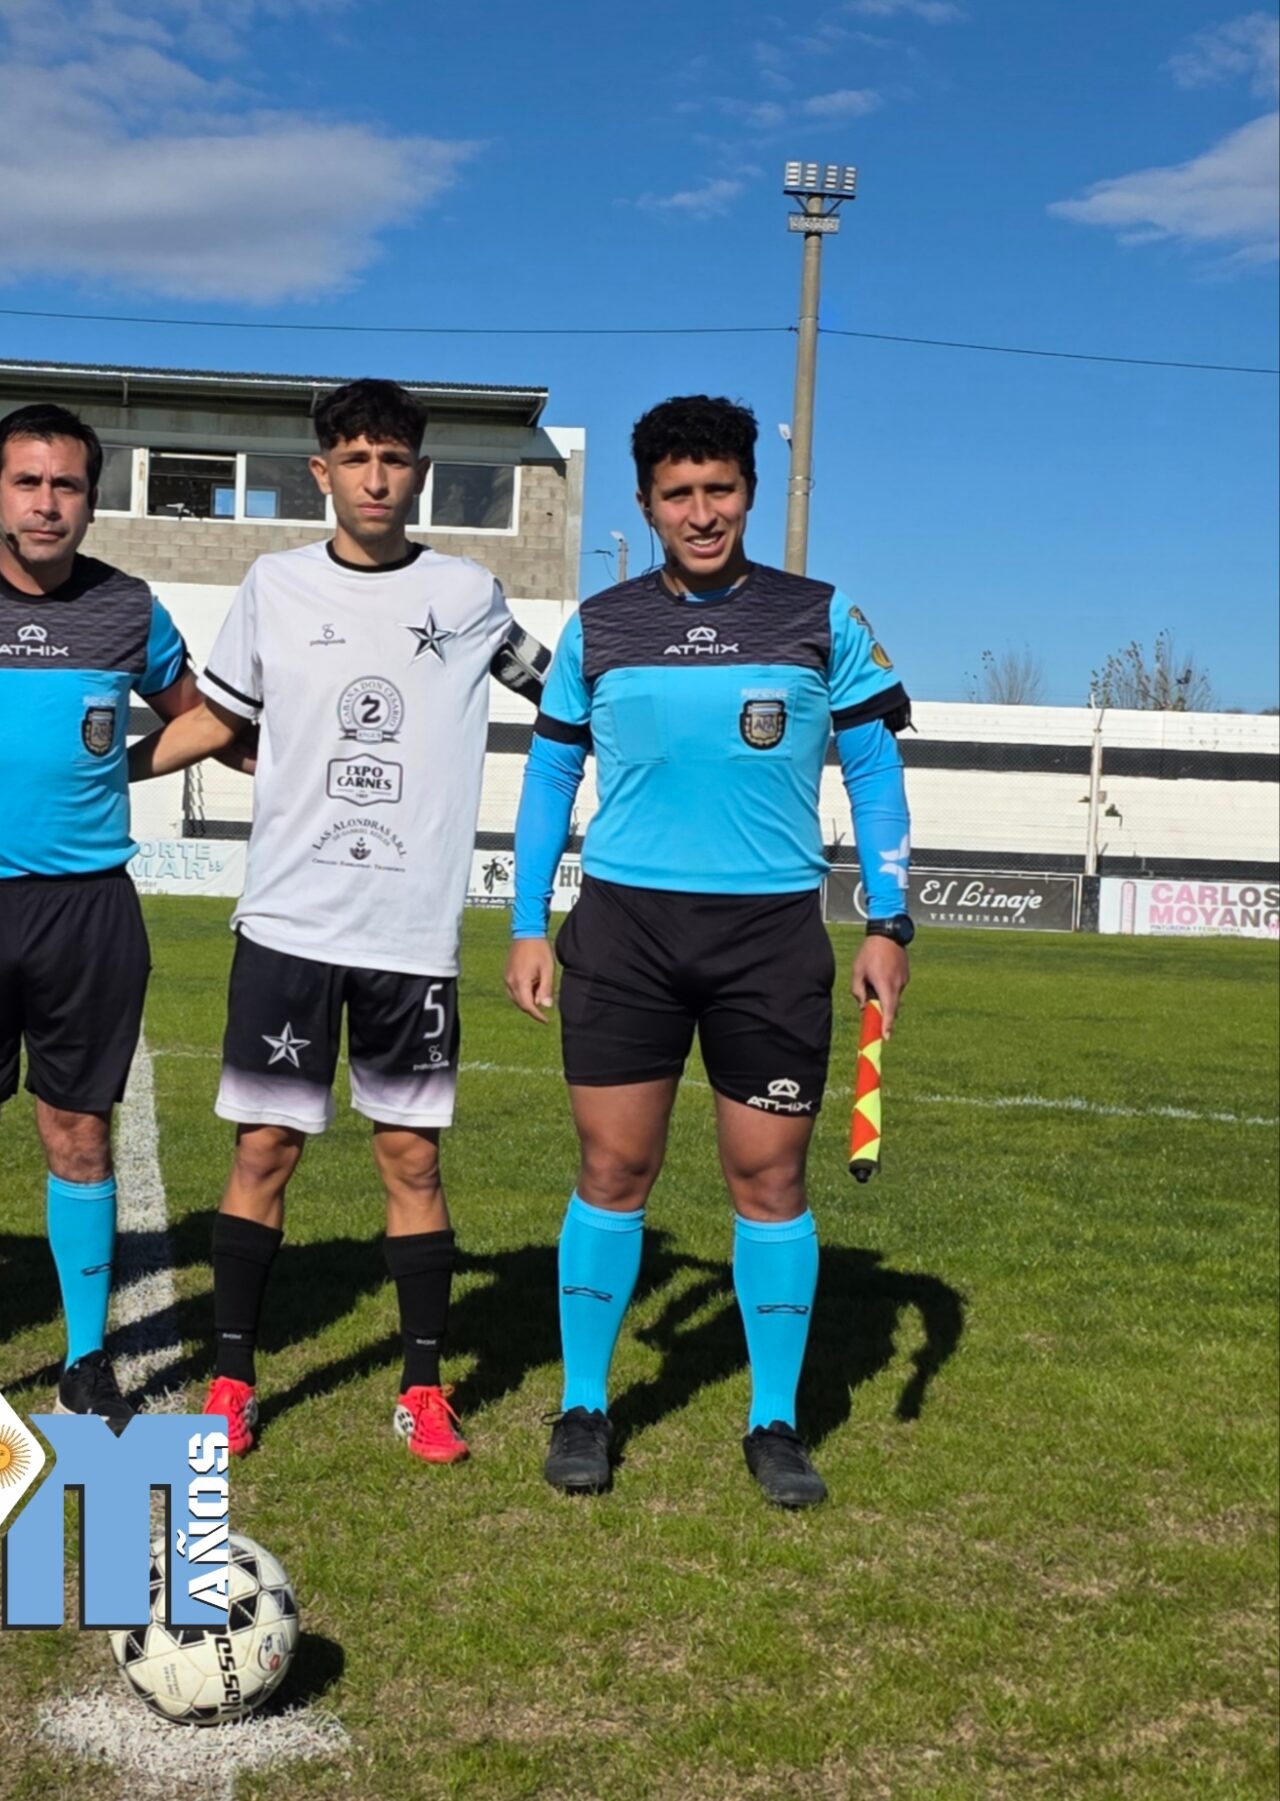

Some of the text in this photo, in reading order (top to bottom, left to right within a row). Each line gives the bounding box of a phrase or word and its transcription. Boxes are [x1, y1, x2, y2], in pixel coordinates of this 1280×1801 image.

[663, 642, 740, 655] ATHIX
[346, 764, 384, 778] EXPO
[337, 776, 392, 790] CARNES
[311, 830, 332, 851] LAS
[332, 818, 391, 836] ALONDRAS
[919, 879, 958, 906] El
[1151, 882, 1280, 908] CARLOS
[423, 983, 445, 1039] 5
[746, 1095, 813, 1112] ATHIX
